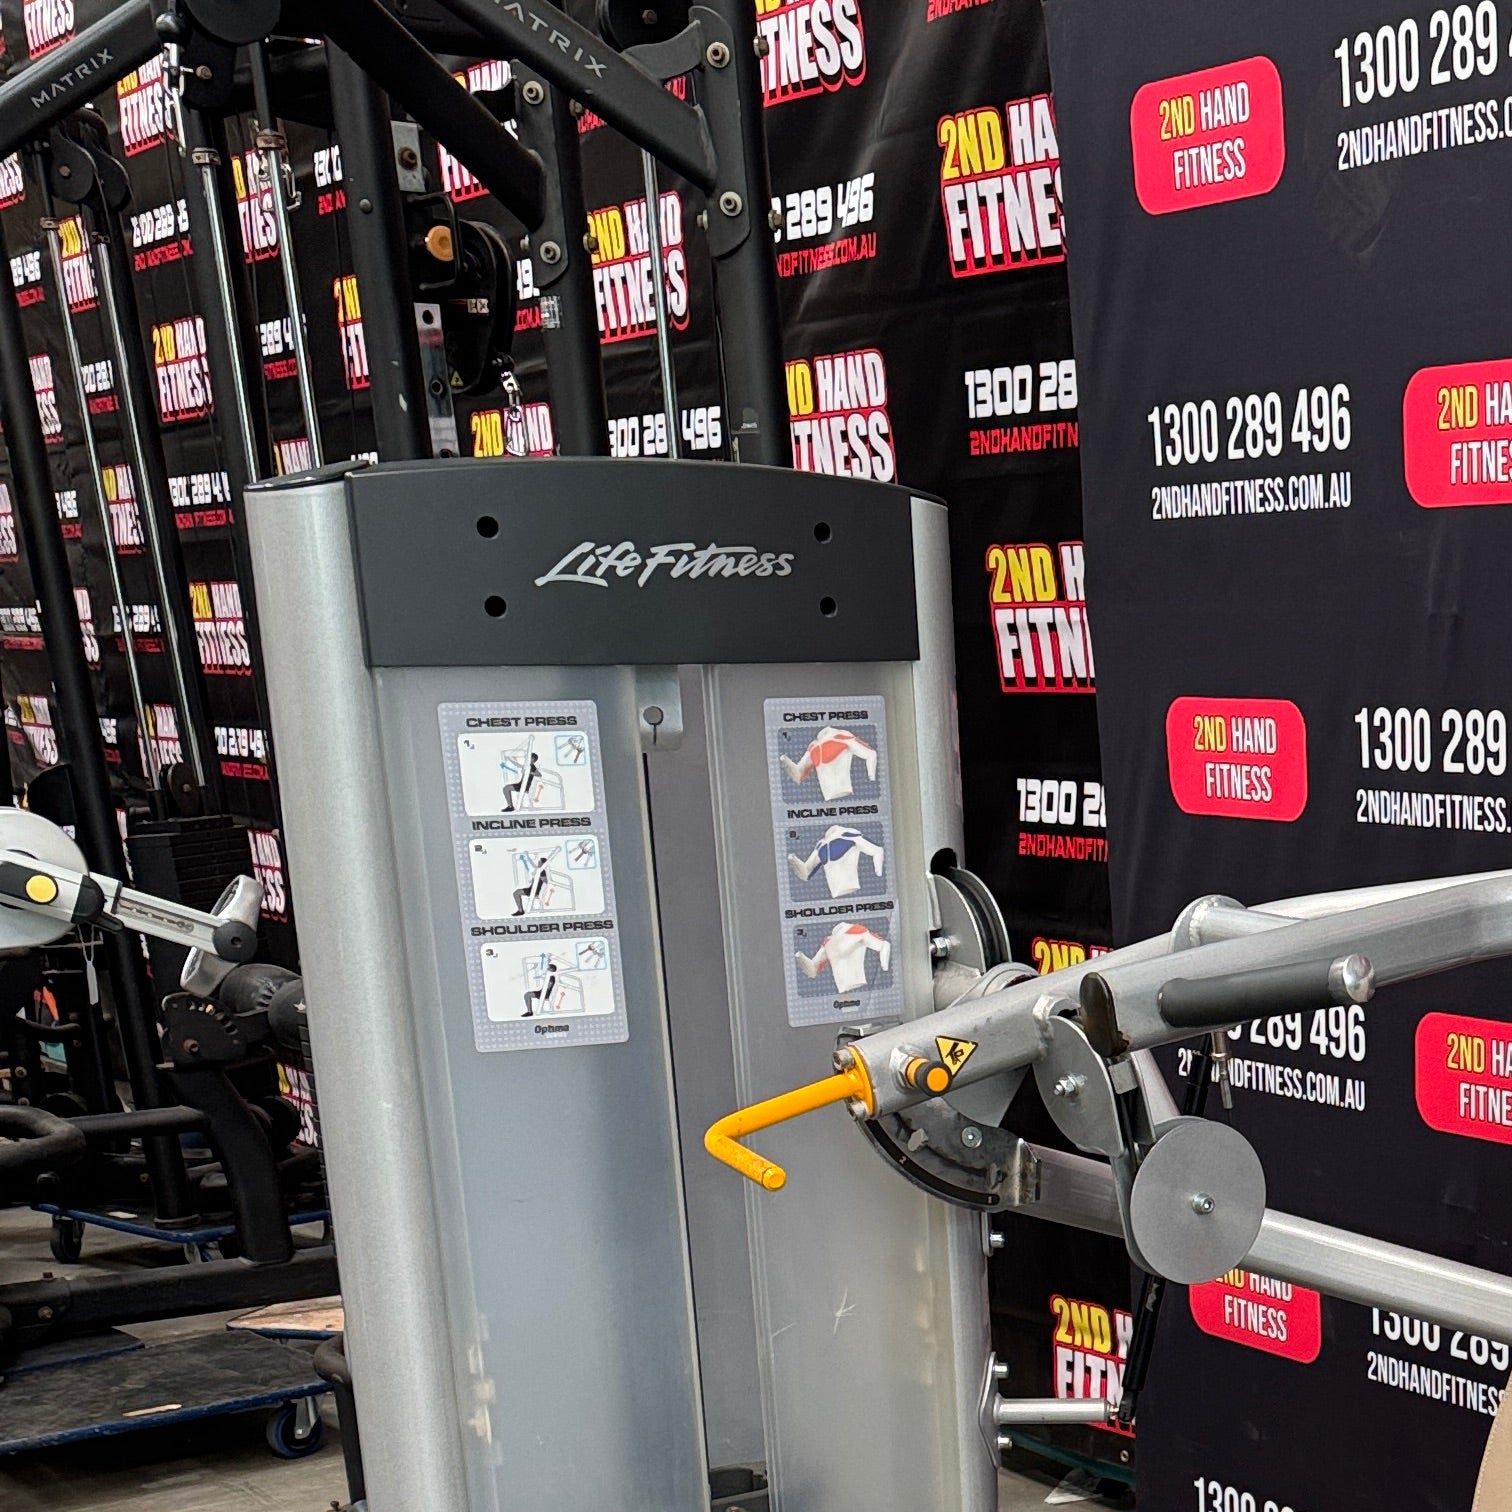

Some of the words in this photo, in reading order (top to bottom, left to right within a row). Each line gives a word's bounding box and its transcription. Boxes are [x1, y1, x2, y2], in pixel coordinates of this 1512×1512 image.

[500, 0, 607, 78] ATRIX
[1334, 19, 1419, 108] 1300
[1429, 0, 1498, 86] 289
[31, 48, 114, 109] MATRIX
[1158, 96, 1195, 141] 2ND
[1200, 81, 1250, 131] HAND
[940, 111, 1005, 180] 2ND
[1173, 137, 1247, 190] FITNESS
[786, 185, 833, 241] 289
[837, 172, 875, 228] 496
[944, 167, 1066, 262] FITNE
[592, 249, 689, 332] FITNES
[815, 352, 887, 413] HAND
[965, 364, 1032, 419] 1300
[682, 405, 722, 451] 496
[1148, 401, 1217, 467] 1300
[1226, 391, 1283, 460] 289
[1292, 383, 1351, 453] 496
[1437, 386, 1478, 431] 2ND
[472, 411, 504, 458] 2ND
[1151, 472, 1351, 520] 2NDHANDFITNESS.COM.AU
[533, 541, 643, 588] Life
[637, 542, 795, 588] Fitness
[988, 546, 1057, 603] 2ND
[466, 717, 521, 728] CHEST
[524, 716, 578, 727] PRESS
[783, 712, 826, 722] CHEST
[828, 710, 869, 721] PRESS
[1193, 714, 1227, 753] 2ND
[1231, 716, 1277, 755] HAND
[1354, 707, 1431, 773] 1300
[1441, 709, 1507, 777] 289
[1016, 778, 1077, 826] 1300
[1204, 761, 1272, 802] FITNESS
[472, 819, 536, 831] INCLINE
[538, 817, 592, 828] PRESS
[787, 807, 837, 819] INCLINE
[839, 804, 879, 816] PRESS
[470, 922, 561, 936] SHOULDER
[562, 920, 614, 932] PRESS
[784, 905, 854, 919] SHOULDER
[856, 901, 894, 913] PRESS
[1310, 1004, 1366, 1061] 496
[1446, 1033, 1485, 1073] 2ND
[1053, 1297, 1111, 1354] 2ND
[1224, 1294, 1288, 1342] FITNESS
